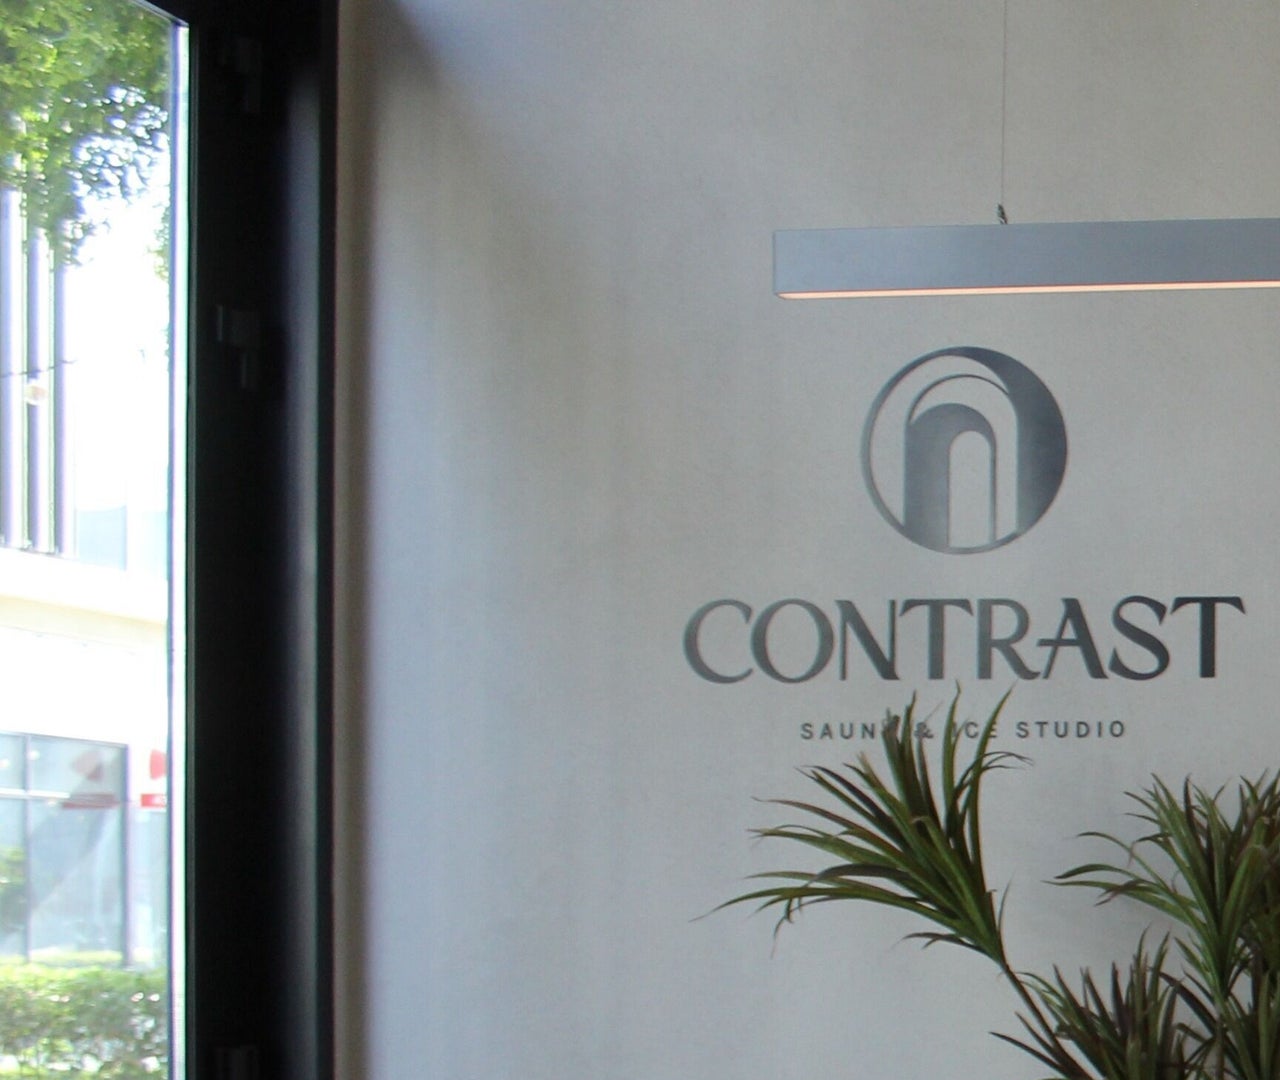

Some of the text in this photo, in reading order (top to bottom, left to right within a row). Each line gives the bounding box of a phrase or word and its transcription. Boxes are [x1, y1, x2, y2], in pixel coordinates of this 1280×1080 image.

[680, 595, 1246, 685] CONTRAST
[800, 722, 902, 740] SAUN
[1016, 720, 1125, 739] STUDIO
